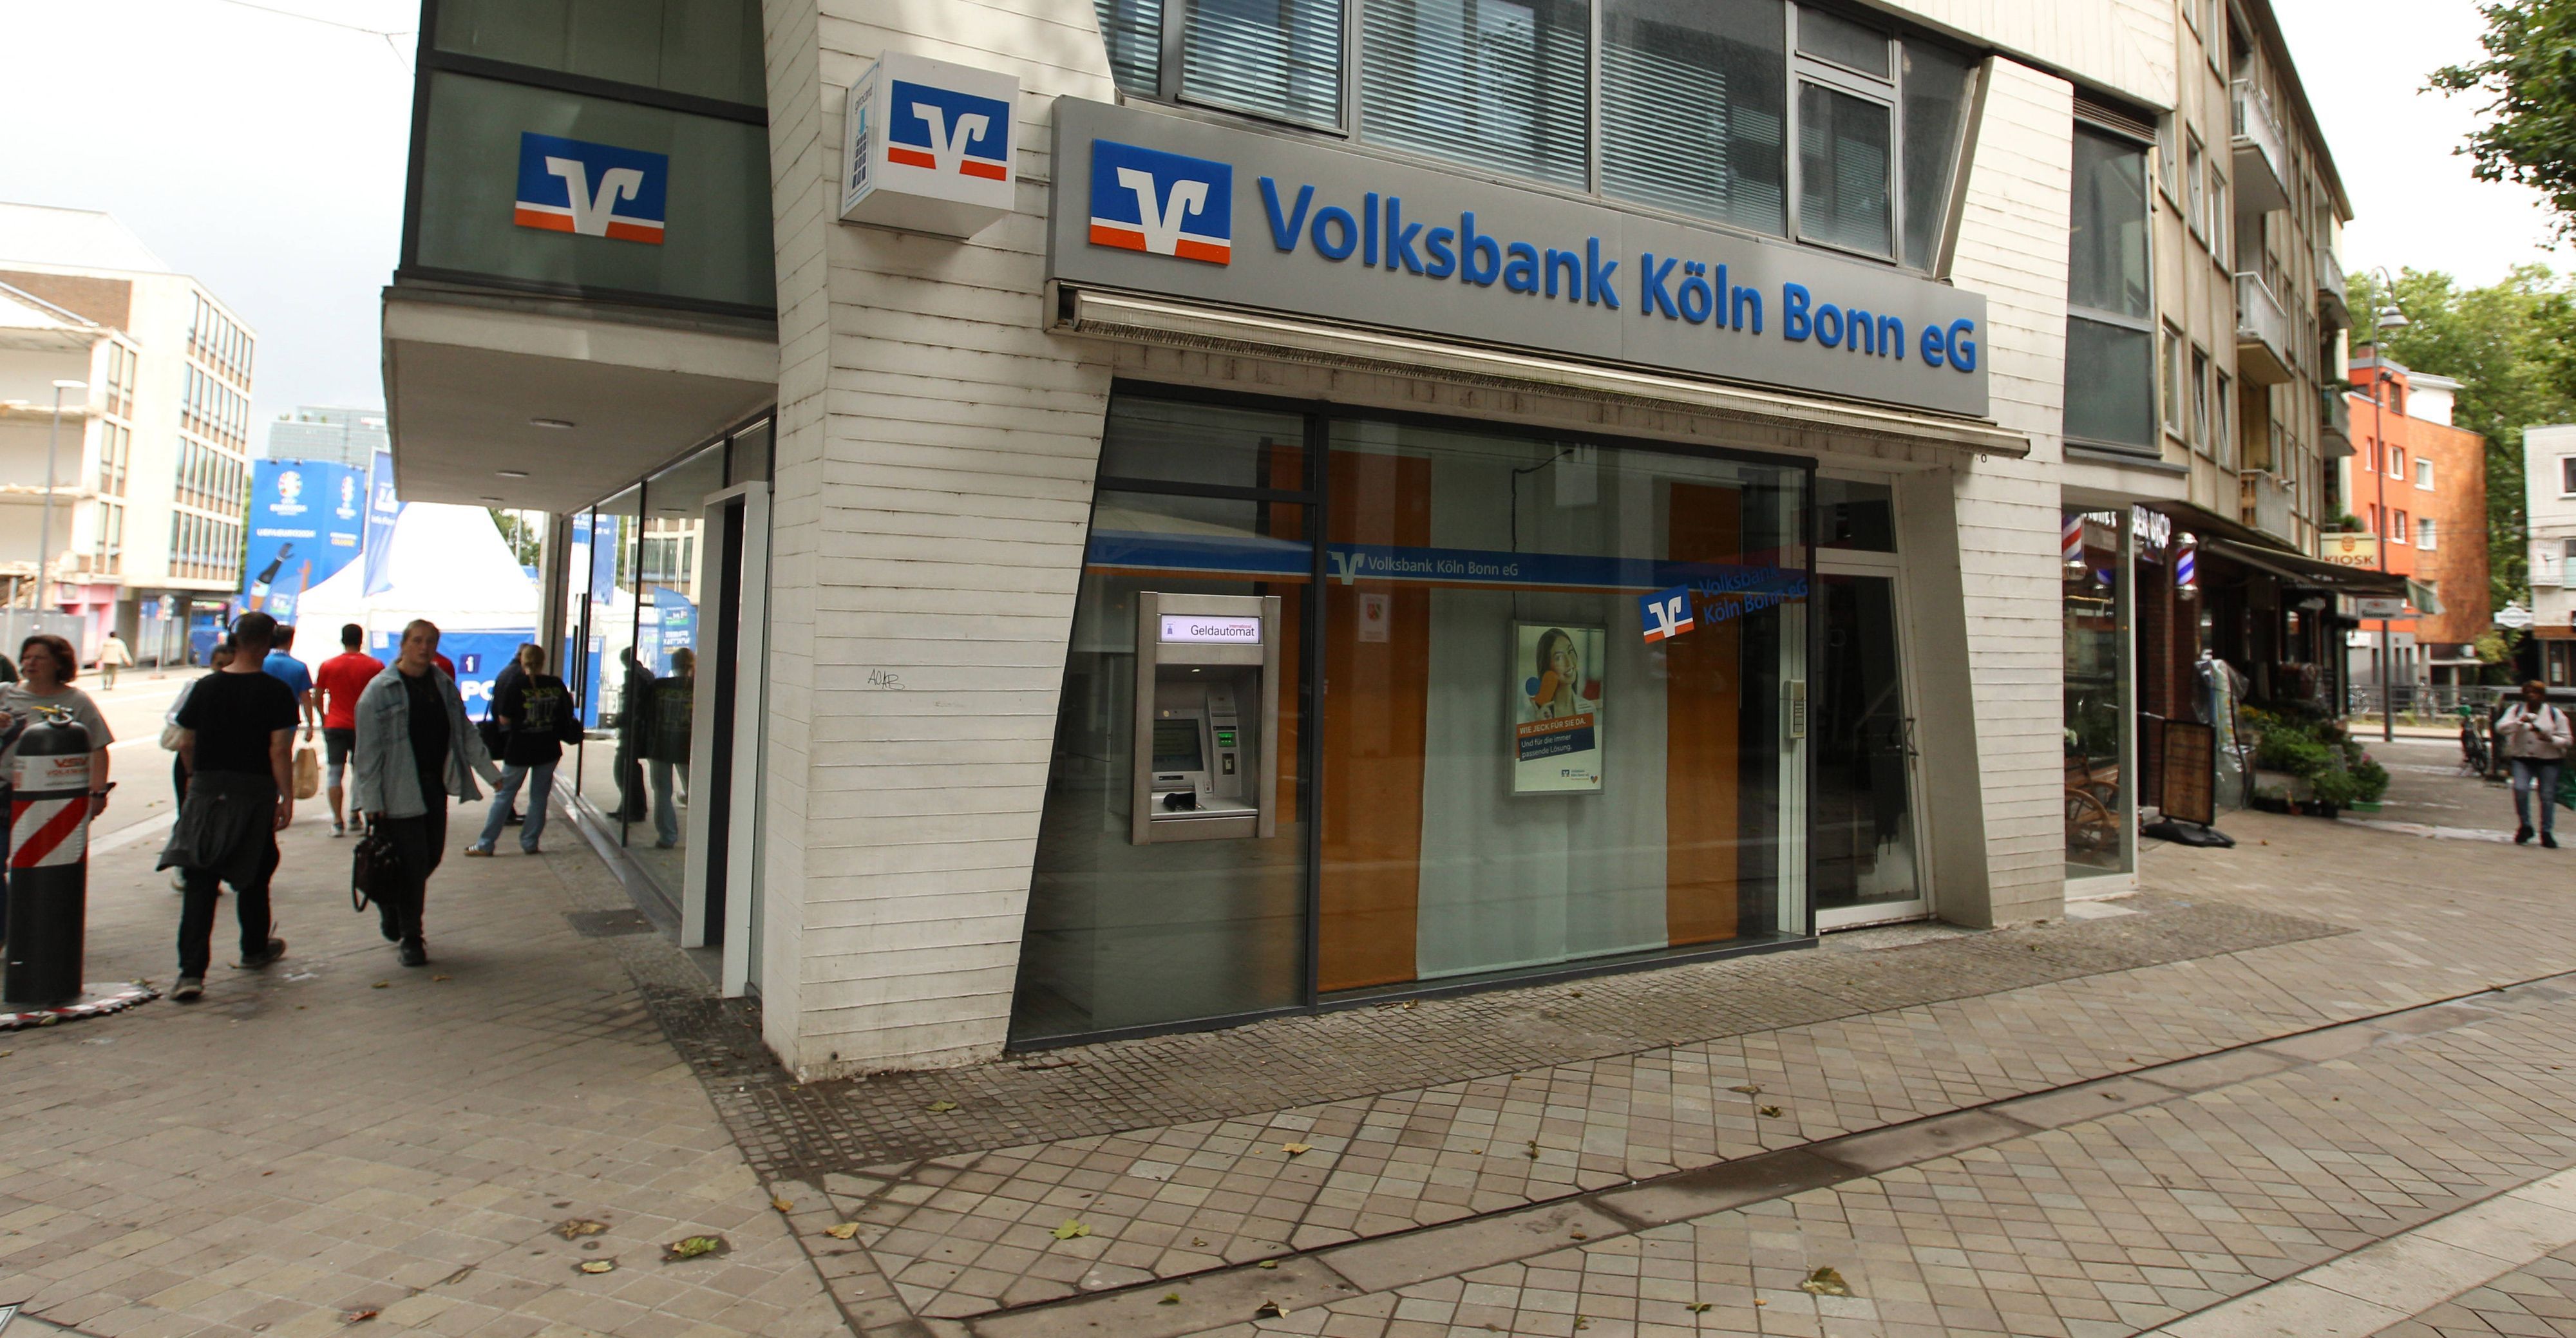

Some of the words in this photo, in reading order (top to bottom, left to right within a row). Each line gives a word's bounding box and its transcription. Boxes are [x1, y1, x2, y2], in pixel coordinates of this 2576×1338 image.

[1258, 176, 1621, 308] Volksbank
[1642, 252, 1763, 334] Köln
[1783, 281, 1905, 359] Bonn
[1920, 318, 1976, 372] eG
[2149, 511, 2171, 548] SHOP
[1368, 556, 1433, 572] Volksbank
[1437, 560, 1464, 574] Köln
[1468, 561, 1499, 576] Bonn
[1502, 563, 1519, 576] eG
[2324, 555, 2374, 565] KIOSK
[1699, 560, 1780, 598] Volksbank
[1703, 598, 1741, 625] Köln
[1743, 588, 1785, 612] Bonn
[1788, 578, 1809, 599] eG
[1191, 625, 1255, 637] Geldautomat
[1533, 724, 1550, 732] JECK
[1551, 721, 1564, 730] FÜR
[1521, 739, 1533, 748] Und
[1544, 735, 1553, 744] die
[1554, 734, 1571, 742] immer
[1522, 747, 1549, 759] passende
